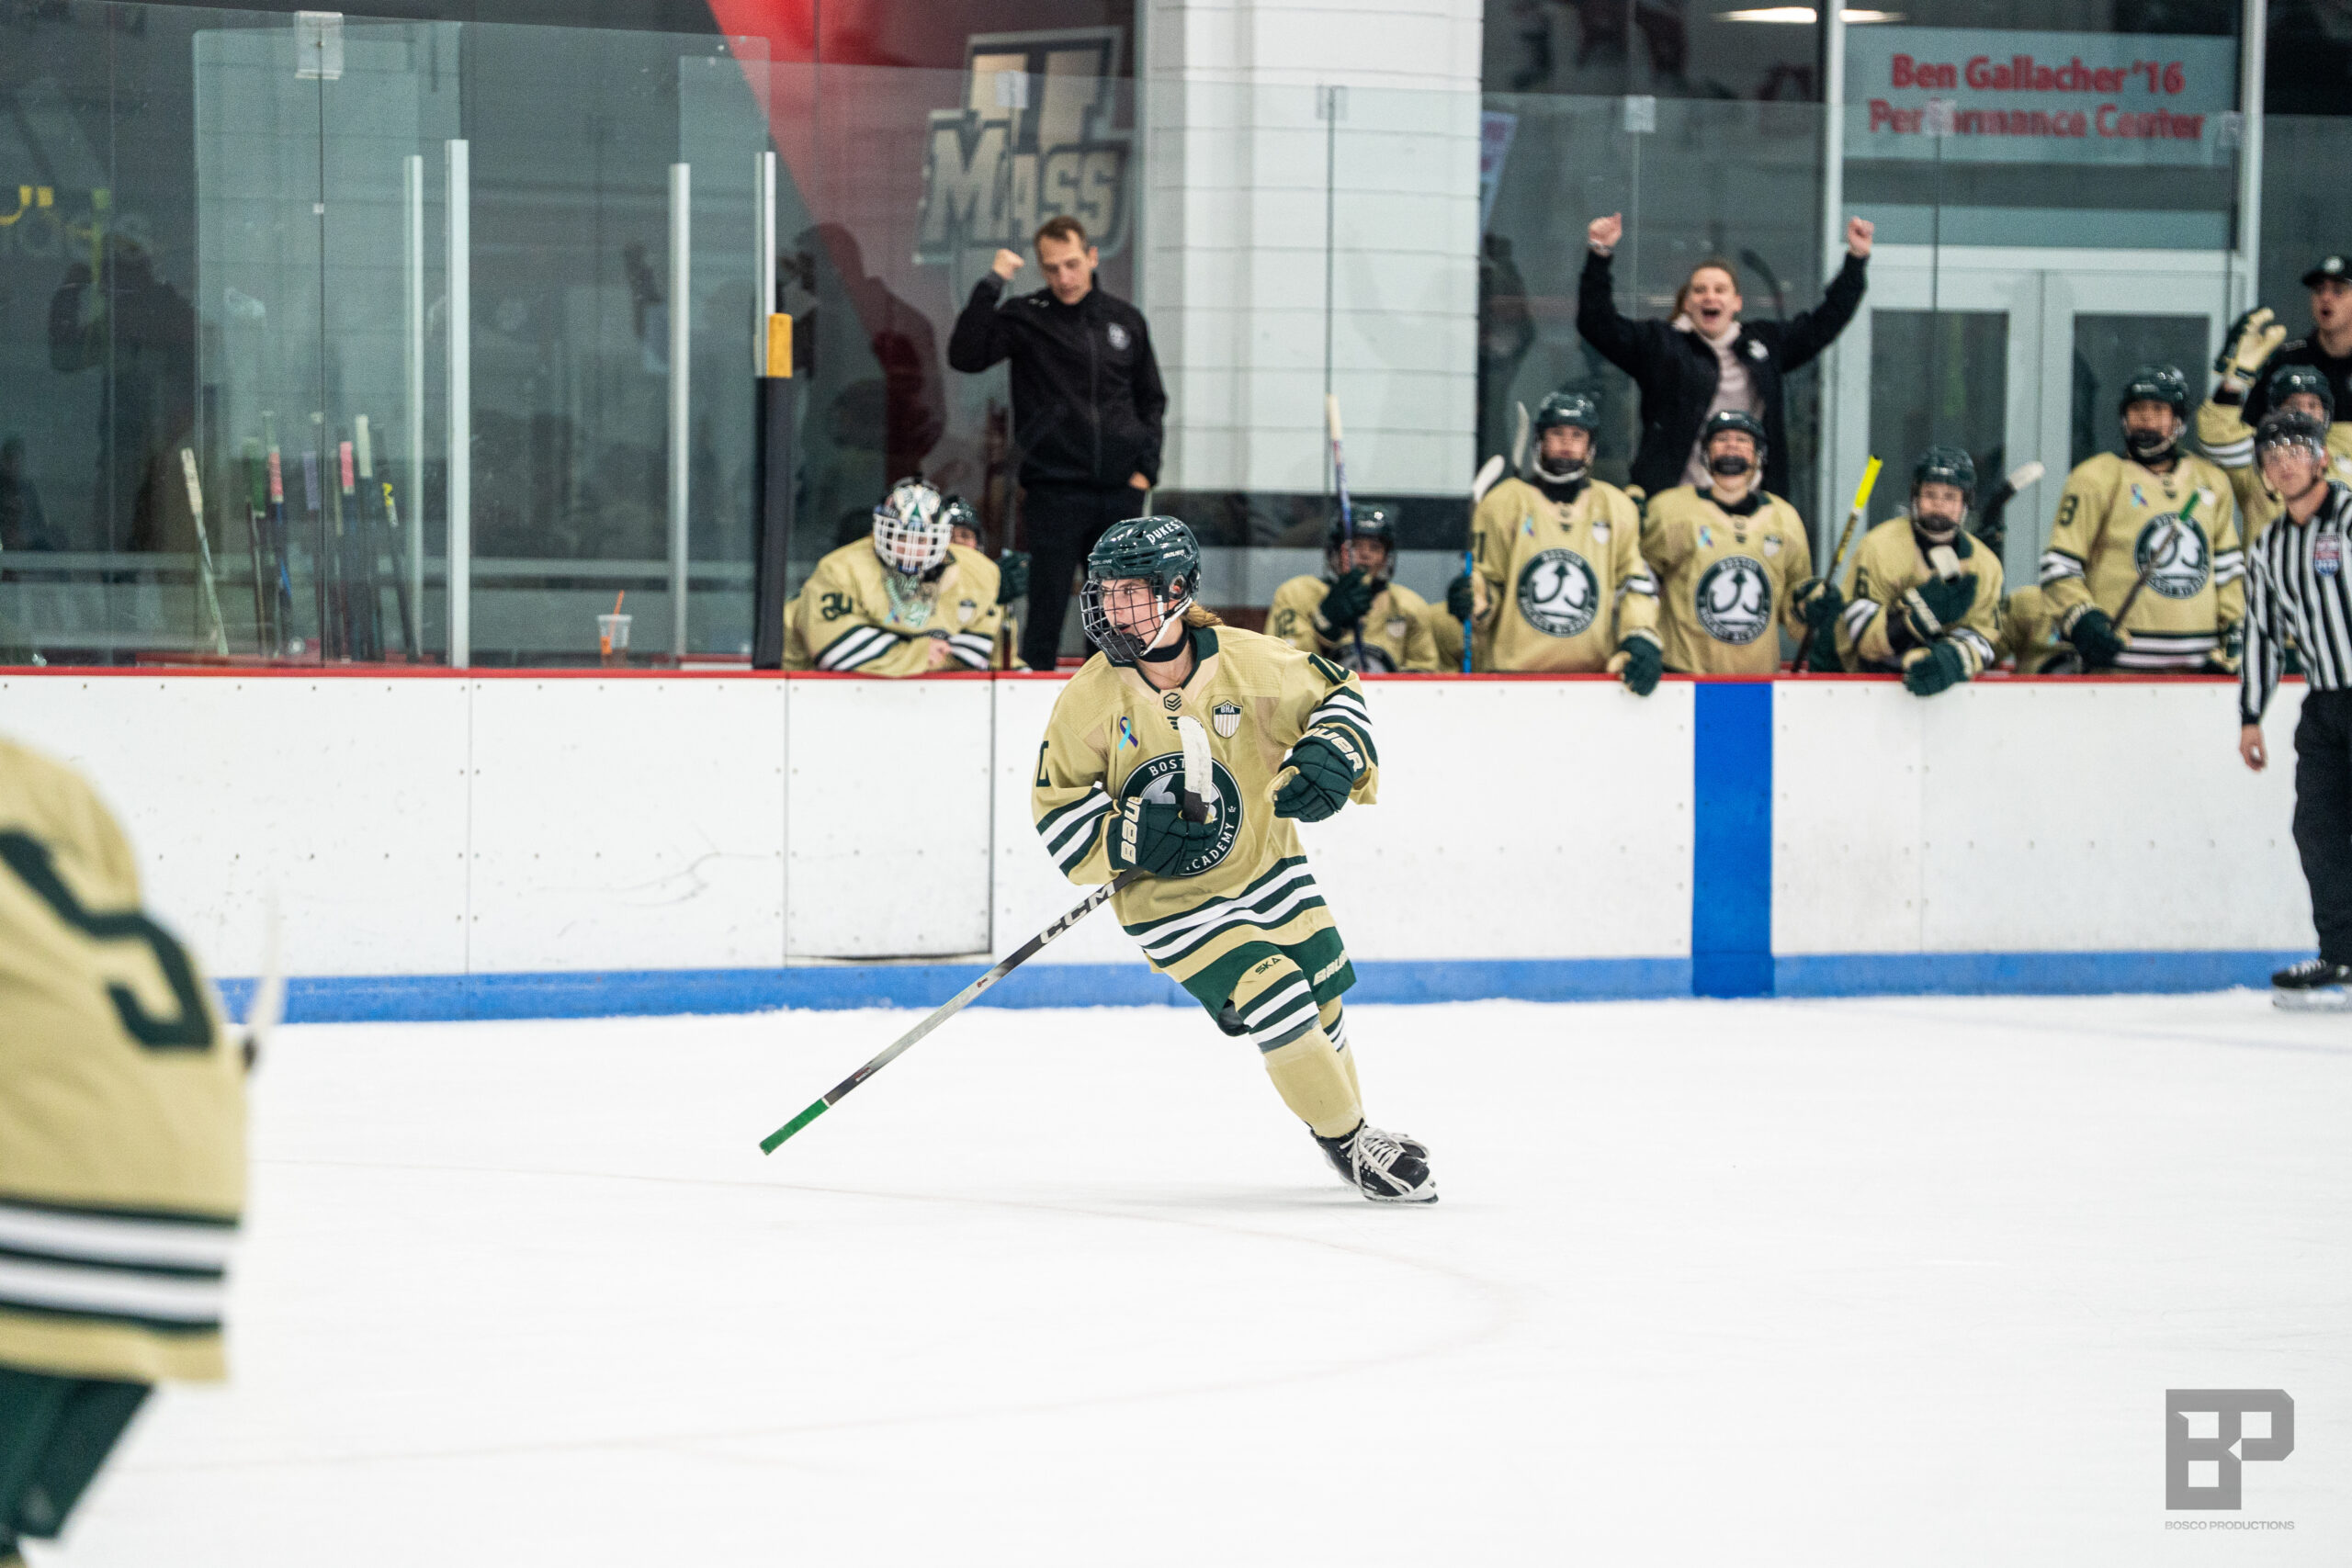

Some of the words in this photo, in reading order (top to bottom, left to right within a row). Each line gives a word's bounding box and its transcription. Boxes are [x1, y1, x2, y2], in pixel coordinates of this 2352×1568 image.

[1891, 53, 1958, 89] Ben
[1964, 55, 2128, 91] Gallacher
[1869, 97, 2087, 138] Perrmance
[2095, 102, 2206, 139] Center
[1146, 521, 1183, 545] DUKES
[1220, 704, 1235, 713] BHA
[1148, 758, 1186, 777] BOST
[1300, 728, 1364, 773] UER
[1185, 822, 1235, 872] CADEMY
[1039, 880, 1116, 944] CCM
[1254, 956, 1282, 976] SKA
